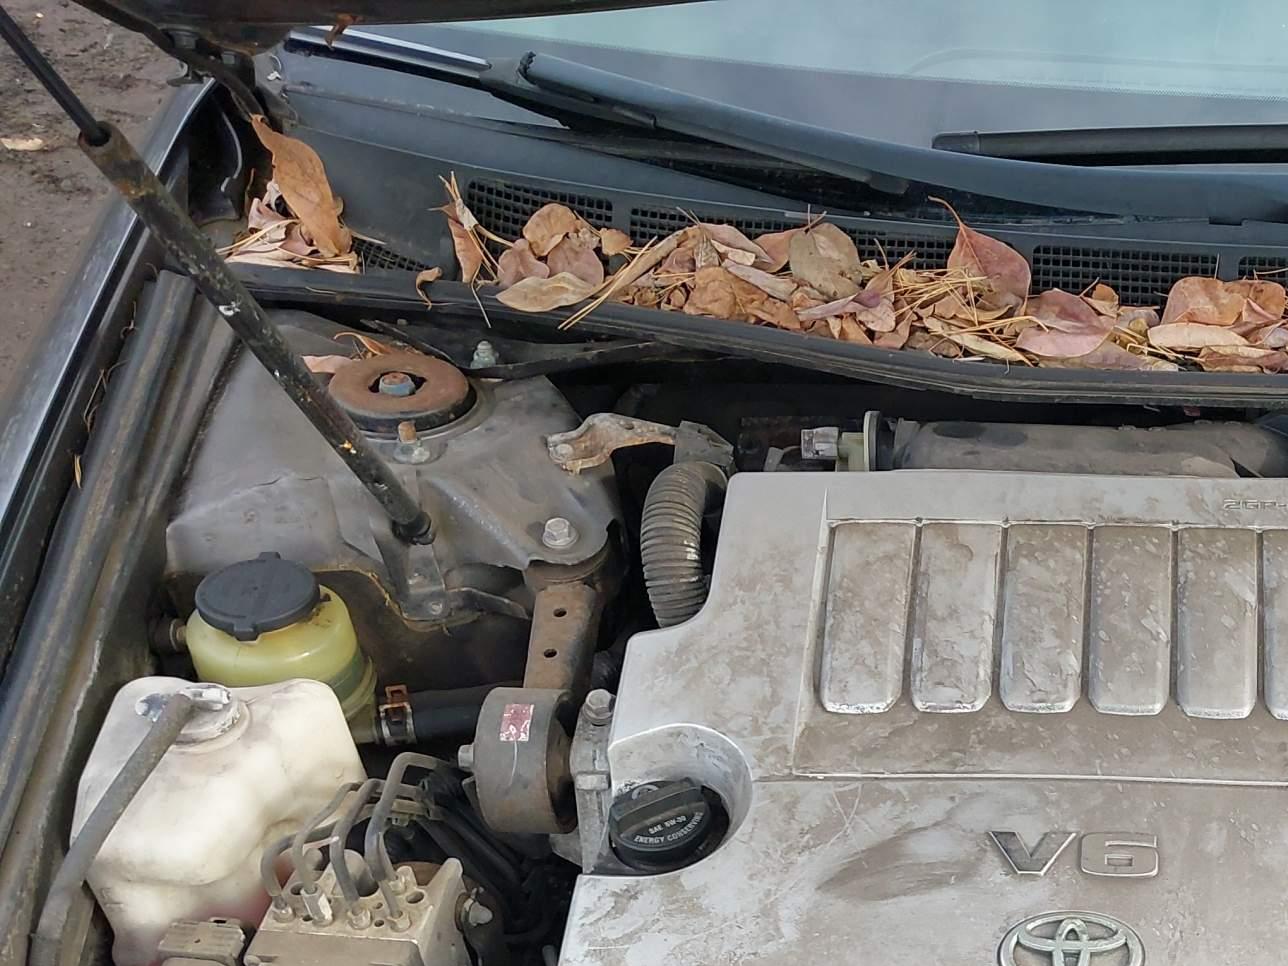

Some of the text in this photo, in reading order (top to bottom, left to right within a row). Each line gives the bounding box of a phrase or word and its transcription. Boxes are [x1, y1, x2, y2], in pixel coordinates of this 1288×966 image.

[648, 825, 663, 835] SAE
[633, 834, 665, 844] ENERGY
[988, 830, 1159, 877] V6
